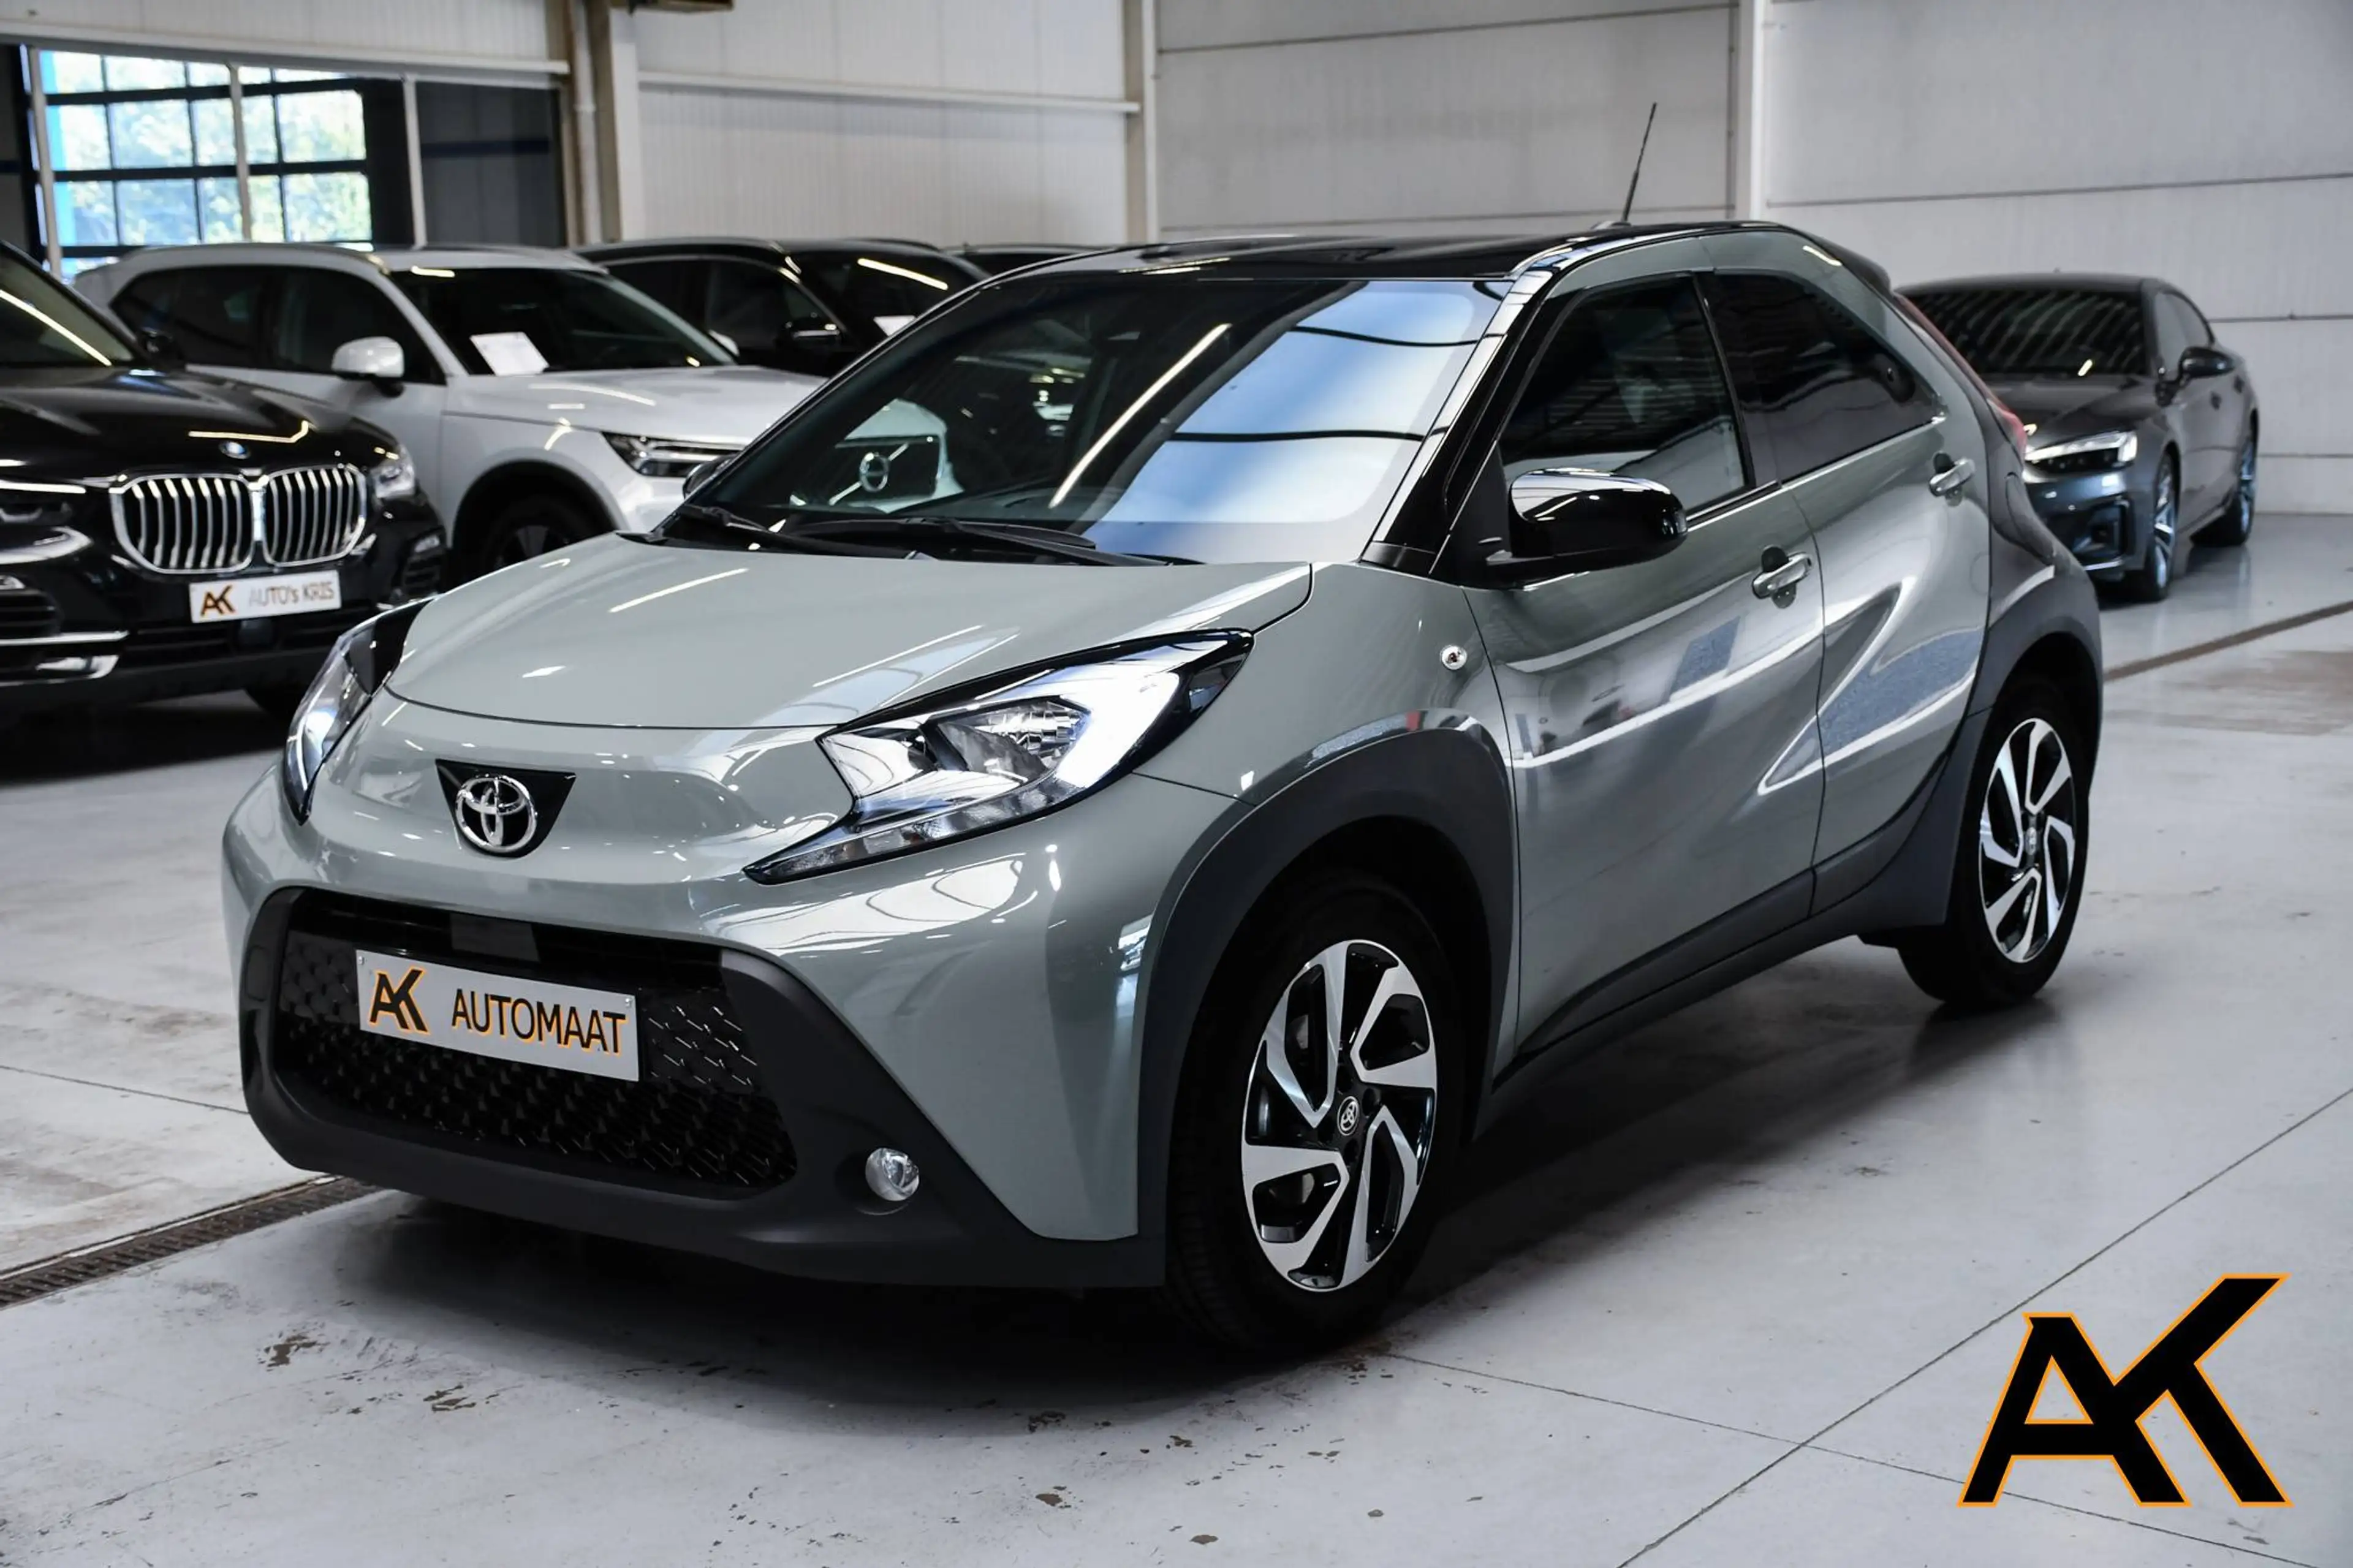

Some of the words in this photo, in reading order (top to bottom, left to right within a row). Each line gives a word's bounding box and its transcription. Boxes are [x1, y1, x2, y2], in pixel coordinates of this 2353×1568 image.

[200, 584, 237, 617] AK
[369, 967, 429, 1034] AK
[451, 988, 626, 1055] AUTOMAAT
